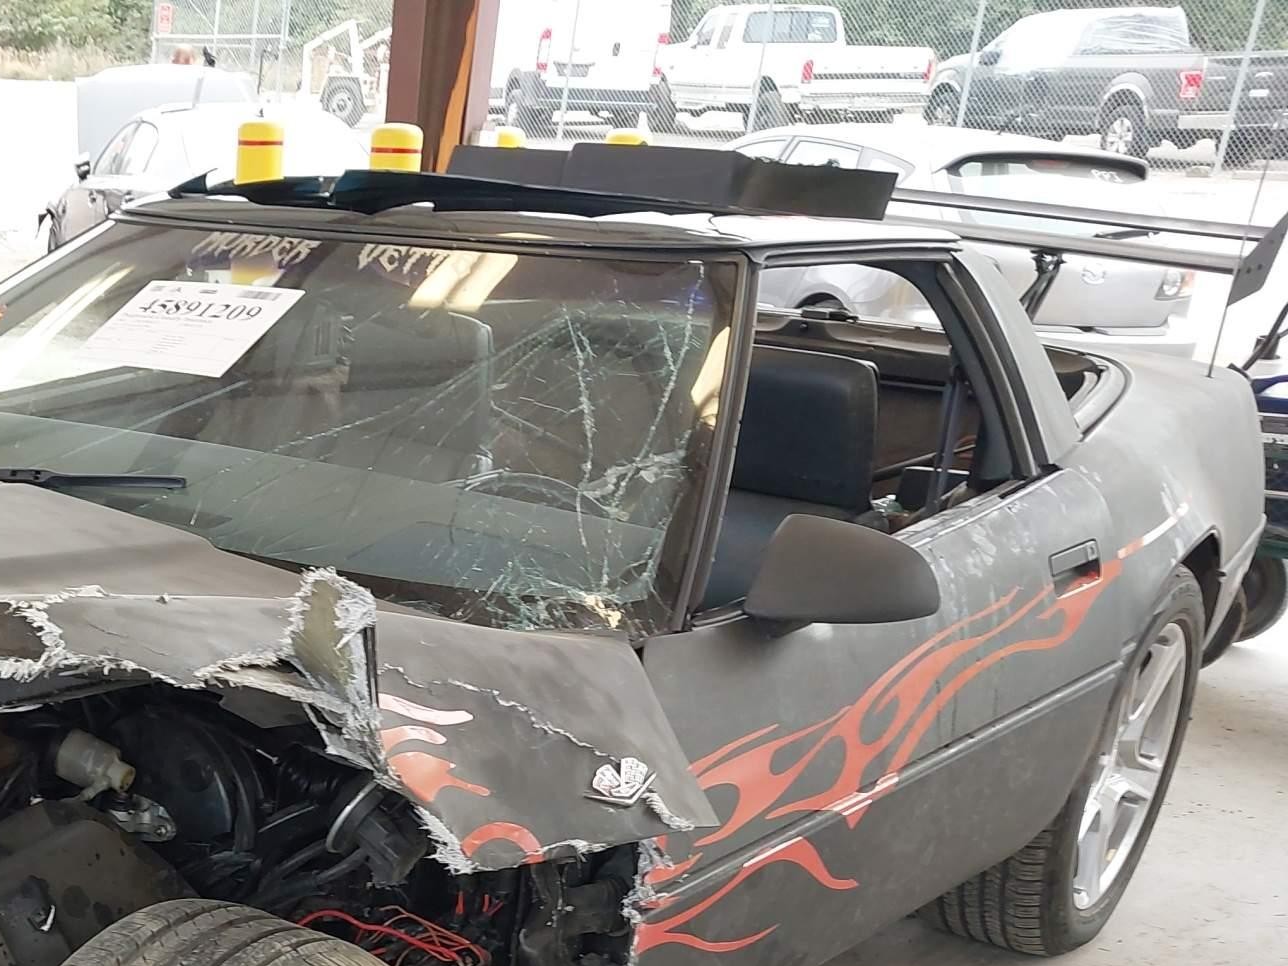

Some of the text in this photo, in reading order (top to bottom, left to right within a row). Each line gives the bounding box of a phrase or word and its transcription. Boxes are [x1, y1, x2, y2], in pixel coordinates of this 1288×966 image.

[191, 231, 474, 277] MURDER VETT
[138, 298, 263, 321] 45891209
